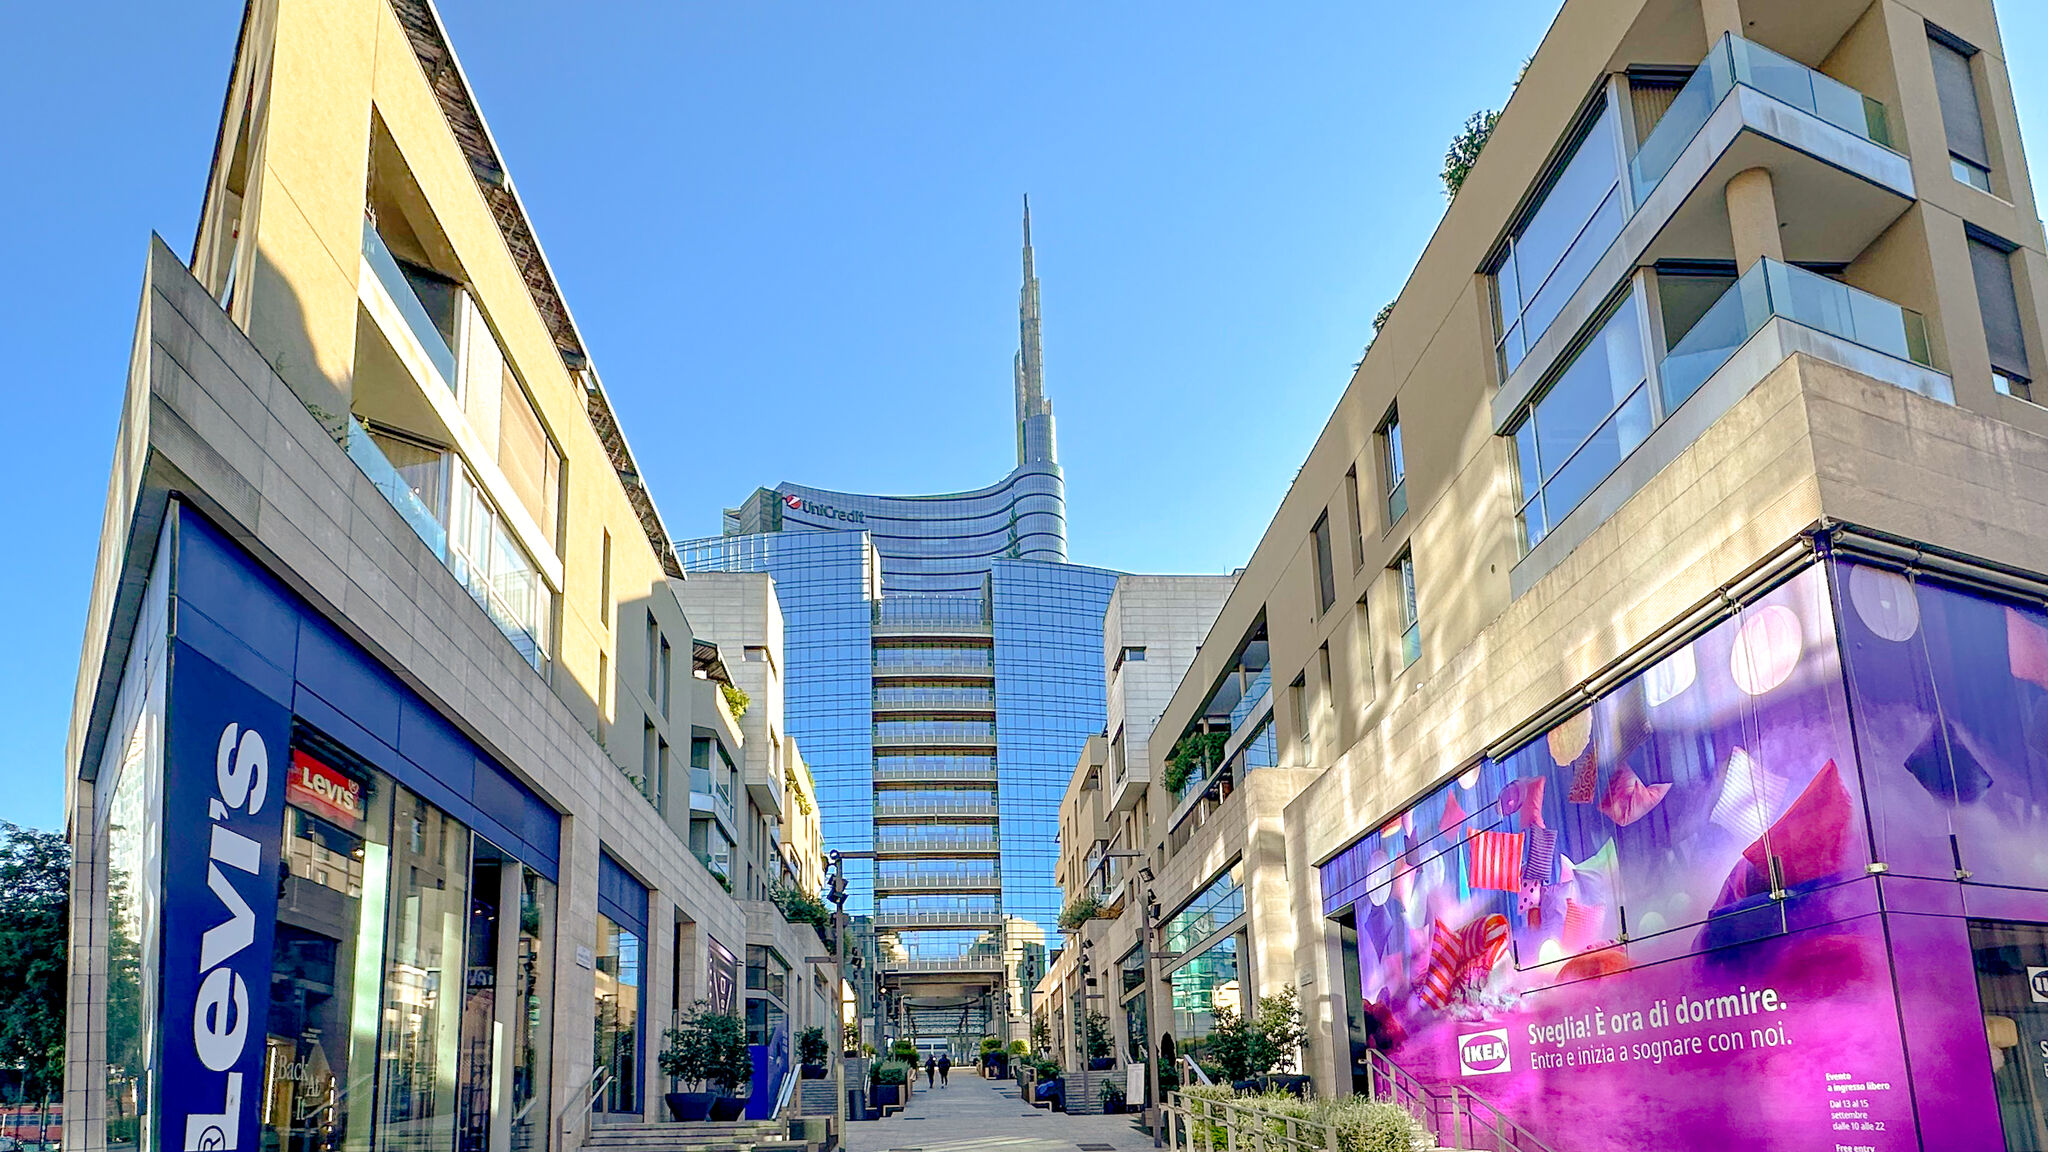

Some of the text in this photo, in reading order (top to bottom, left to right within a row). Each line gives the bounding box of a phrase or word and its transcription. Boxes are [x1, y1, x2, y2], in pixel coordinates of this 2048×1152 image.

[801, 499, 866, 524] UniCredit
[1528, 985, 1788, 1047] Sveglia! È ora di dormire.
[1530, 1020, 1793, 1070] Entra e inizia a sognare con noi.
[1463, 1041, 1506, 1063] IKEA
[277, 1054, 309, 1082] Back
[1825, 1072, 1852, 1081] Evento
[1833, 1083, 1865, 1094] ingresso
[1866, 1081, 1891, 1091] libero
[1829, 1099, 1869, 1108] Dal 13 al 15
[1831, 1110, 1868, 1120] settembre
[1832, 1121, 1886, 1132] dalle 10 alle 22
[1835, 1144, 1853, 1152] Free
